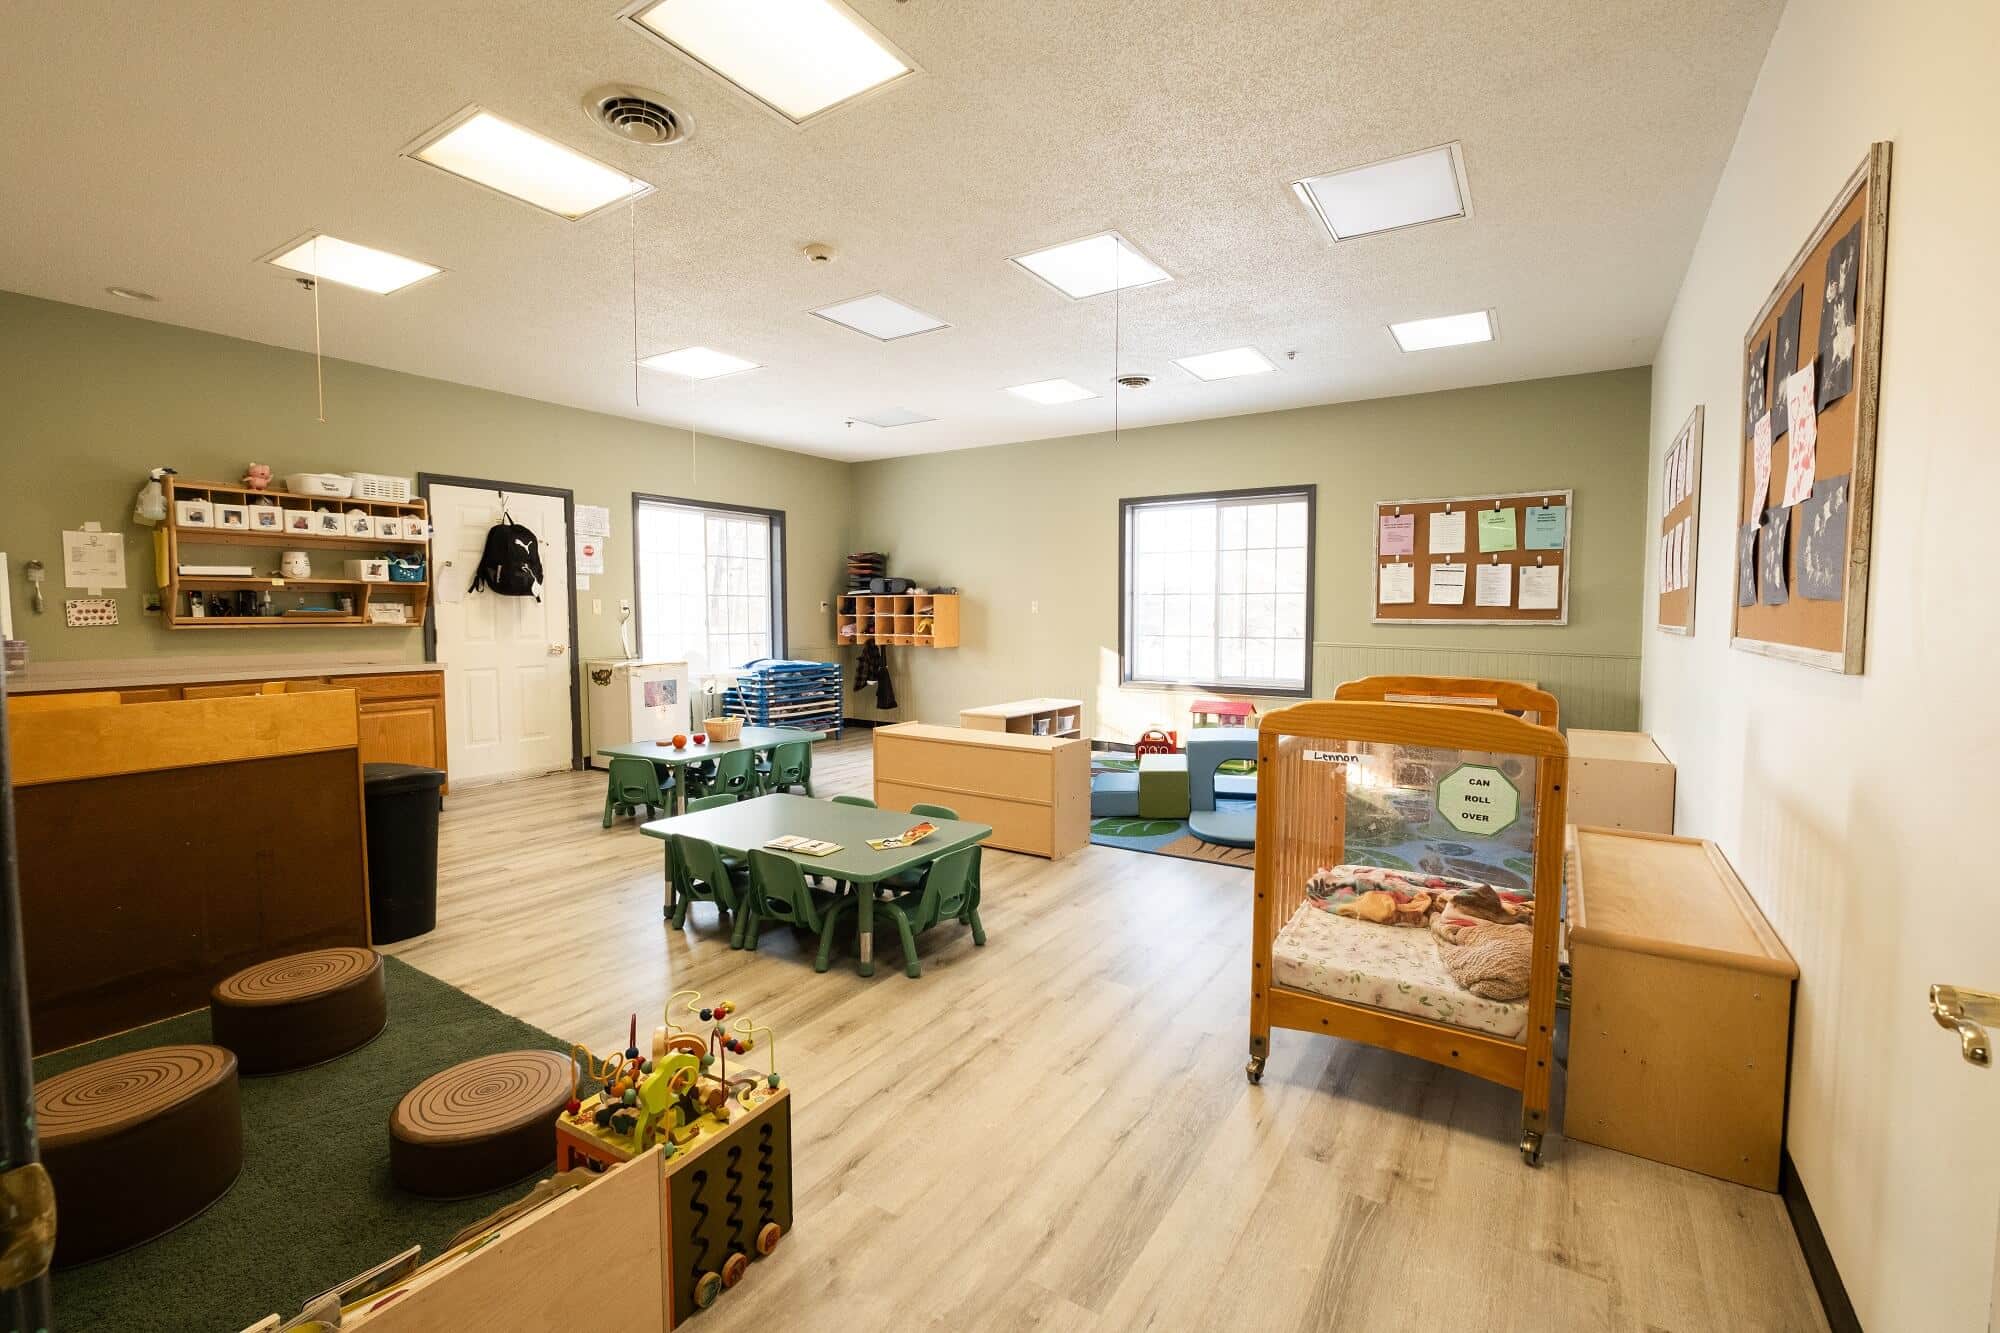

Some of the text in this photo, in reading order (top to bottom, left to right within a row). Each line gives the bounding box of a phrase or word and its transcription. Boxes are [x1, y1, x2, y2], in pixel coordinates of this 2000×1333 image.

[1314, 752, 1359, 762] Lennon
[1469, 778, 1490, 787] CAN
[1464, 795, 1491, 804] ROLL
[1461, 812, 1489, 822] OVER
